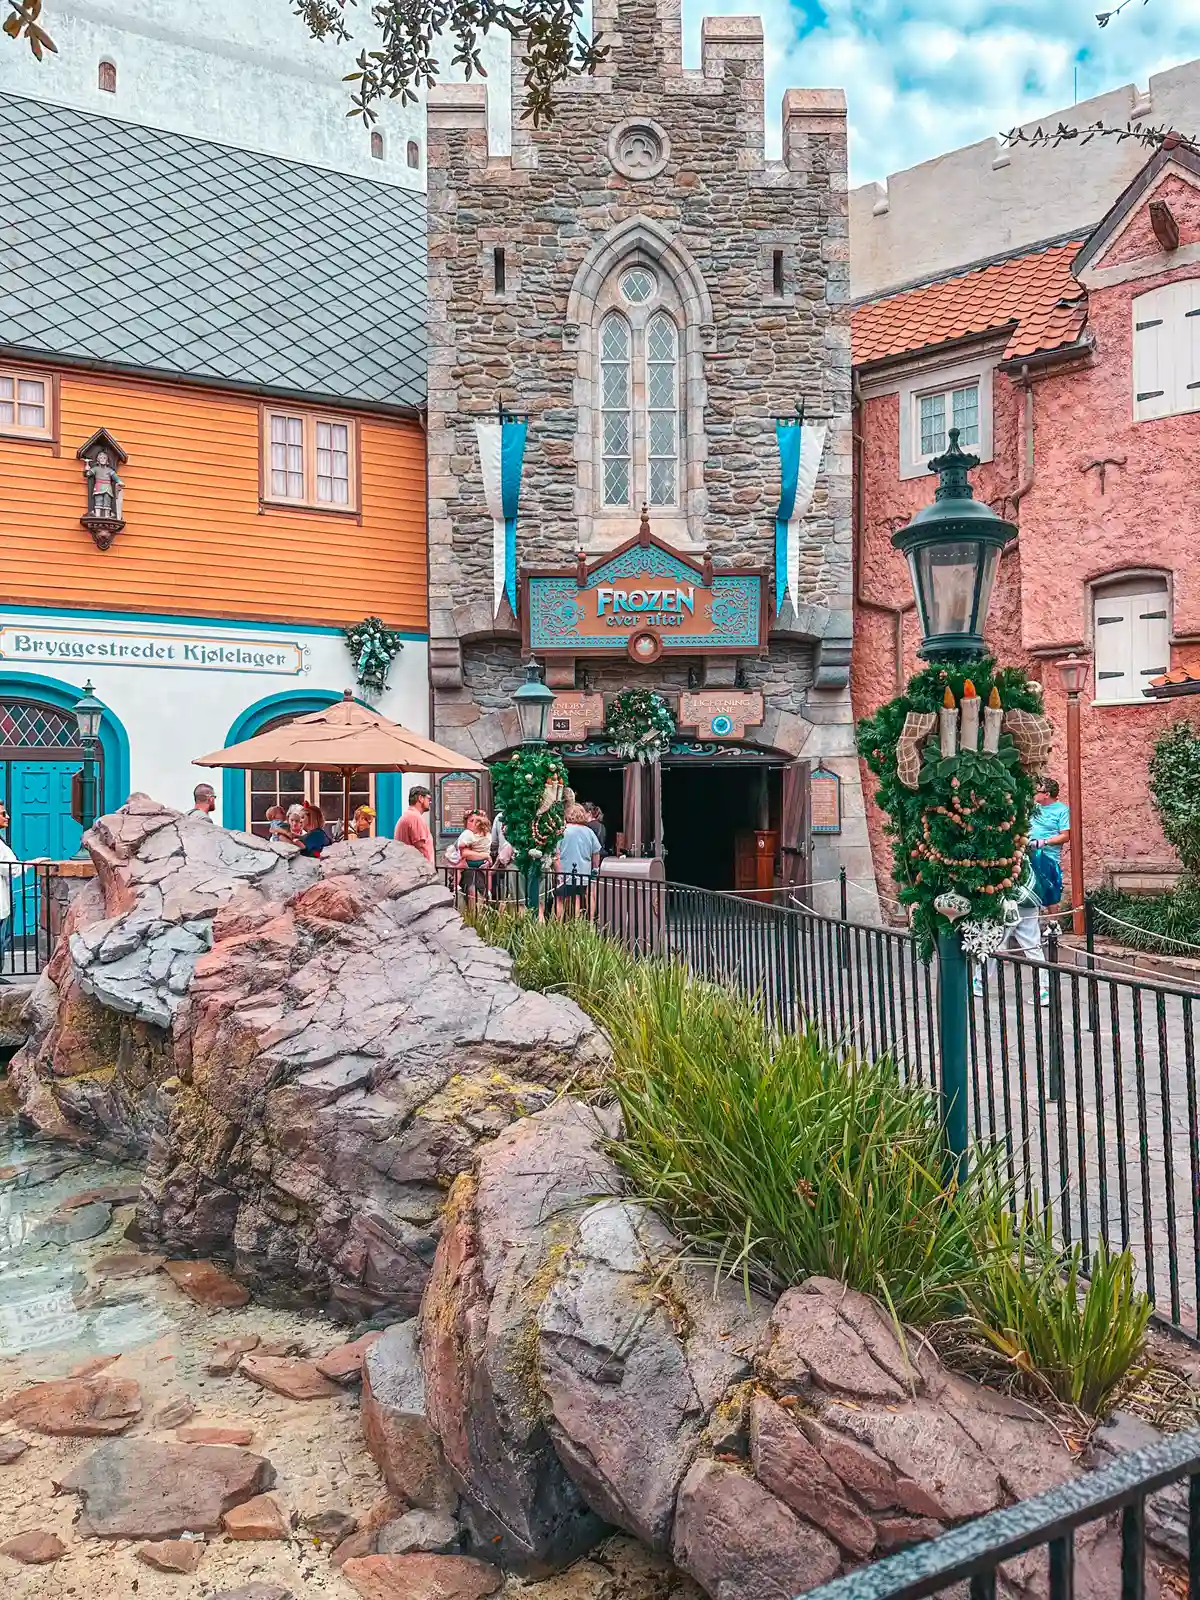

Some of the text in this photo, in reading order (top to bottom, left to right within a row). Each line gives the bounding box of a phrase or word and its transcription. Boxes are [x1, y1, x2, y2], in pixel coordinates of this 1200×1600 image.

[596, 587, 695, 617] FROZEN
[606, 612, 685, 627] ever after
[14, 634, 286, 667] Bryggestredet Kjølelager
[693, 699, 750, 707] LIGHTNING
